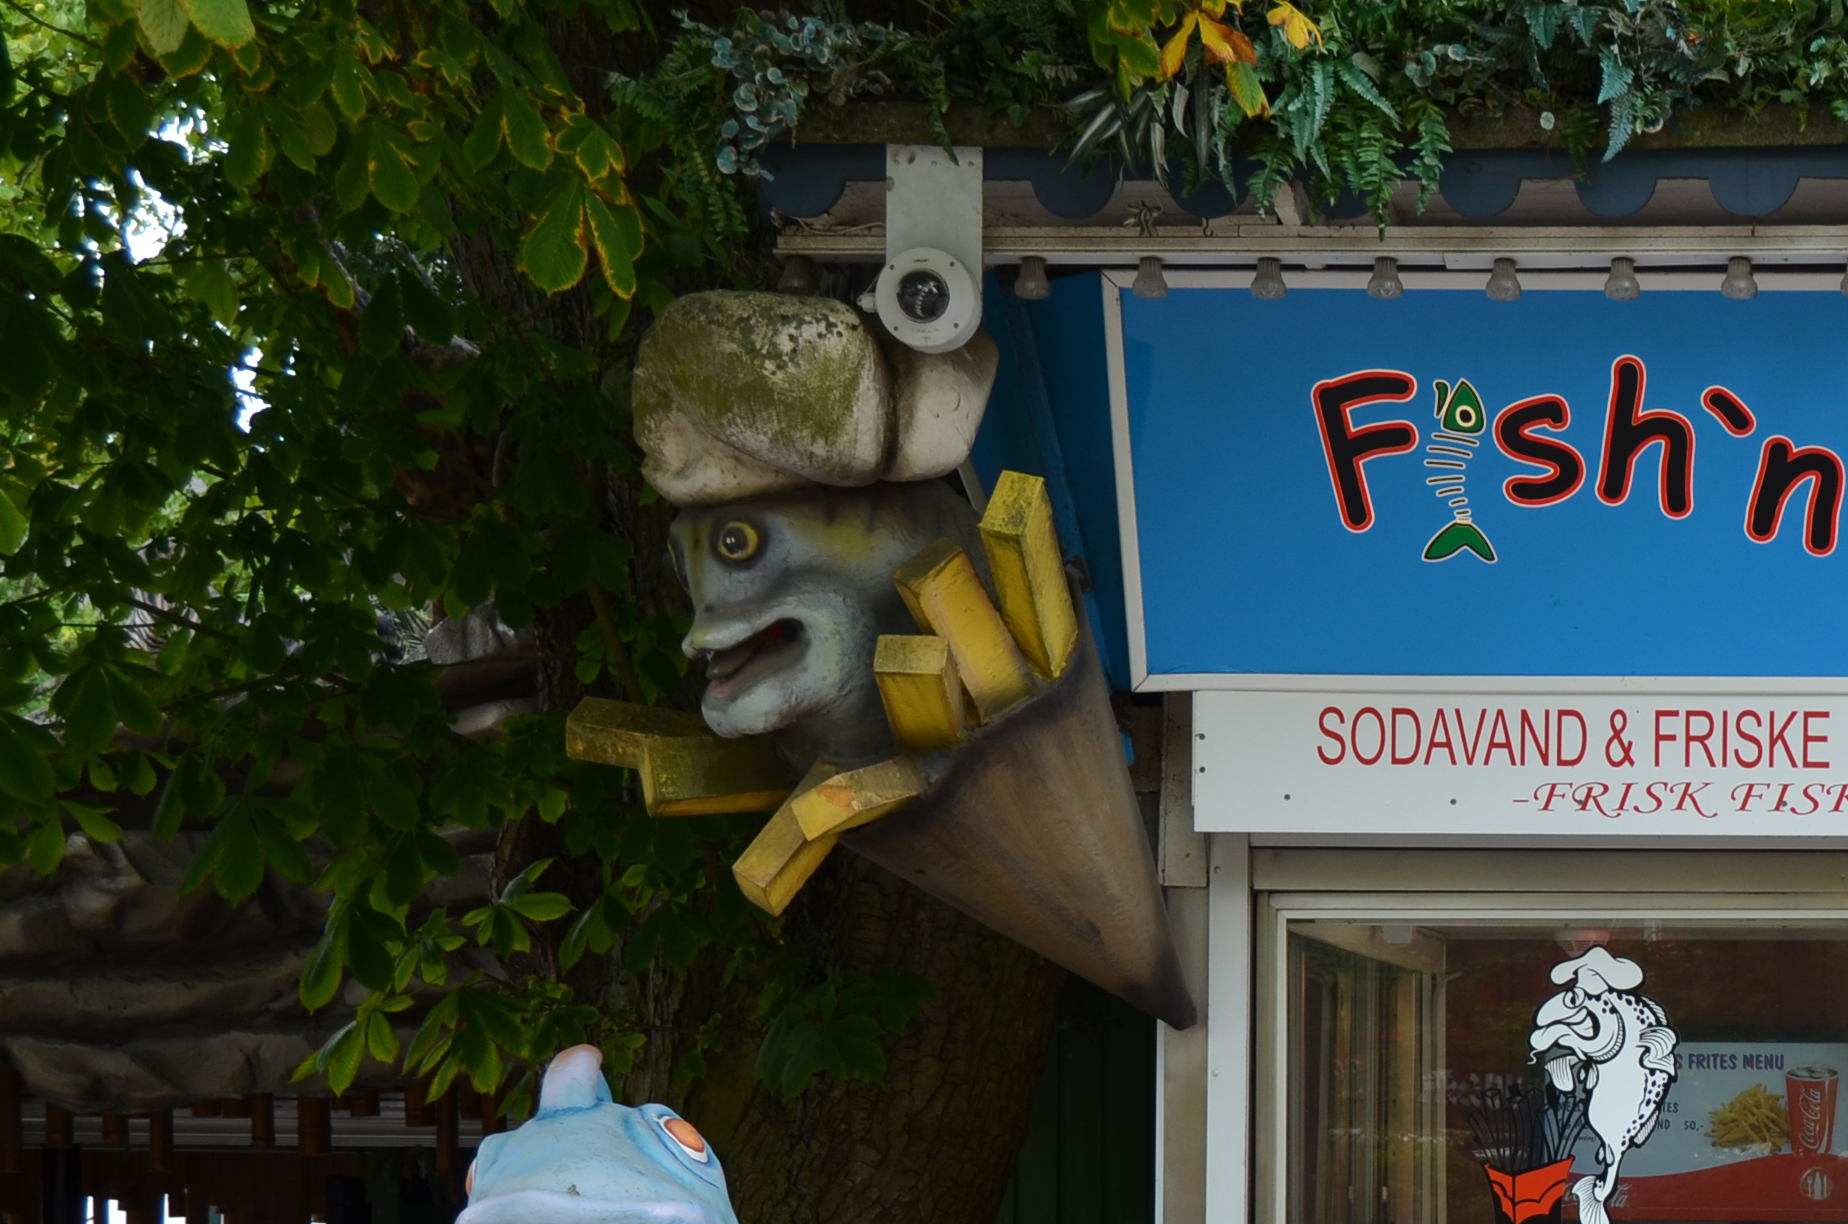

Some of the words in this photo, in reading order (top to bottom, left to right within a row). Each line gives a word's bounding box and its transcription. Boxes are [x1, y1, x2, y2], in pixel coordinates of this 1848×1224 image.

[1316, 706, 1587, 767] SODAVAND
[1604, 709, 1635, 769] &
[1653, 709, 1831, 769] FRISKE
[1688, 1053, 1738, 1070] FRITES
[1743, 1054, 1785, 1070] MENU
[1683, 1119, 1704, 1133] 50,-
[1797, 1082, 1823, 1150] Coca-Cola
